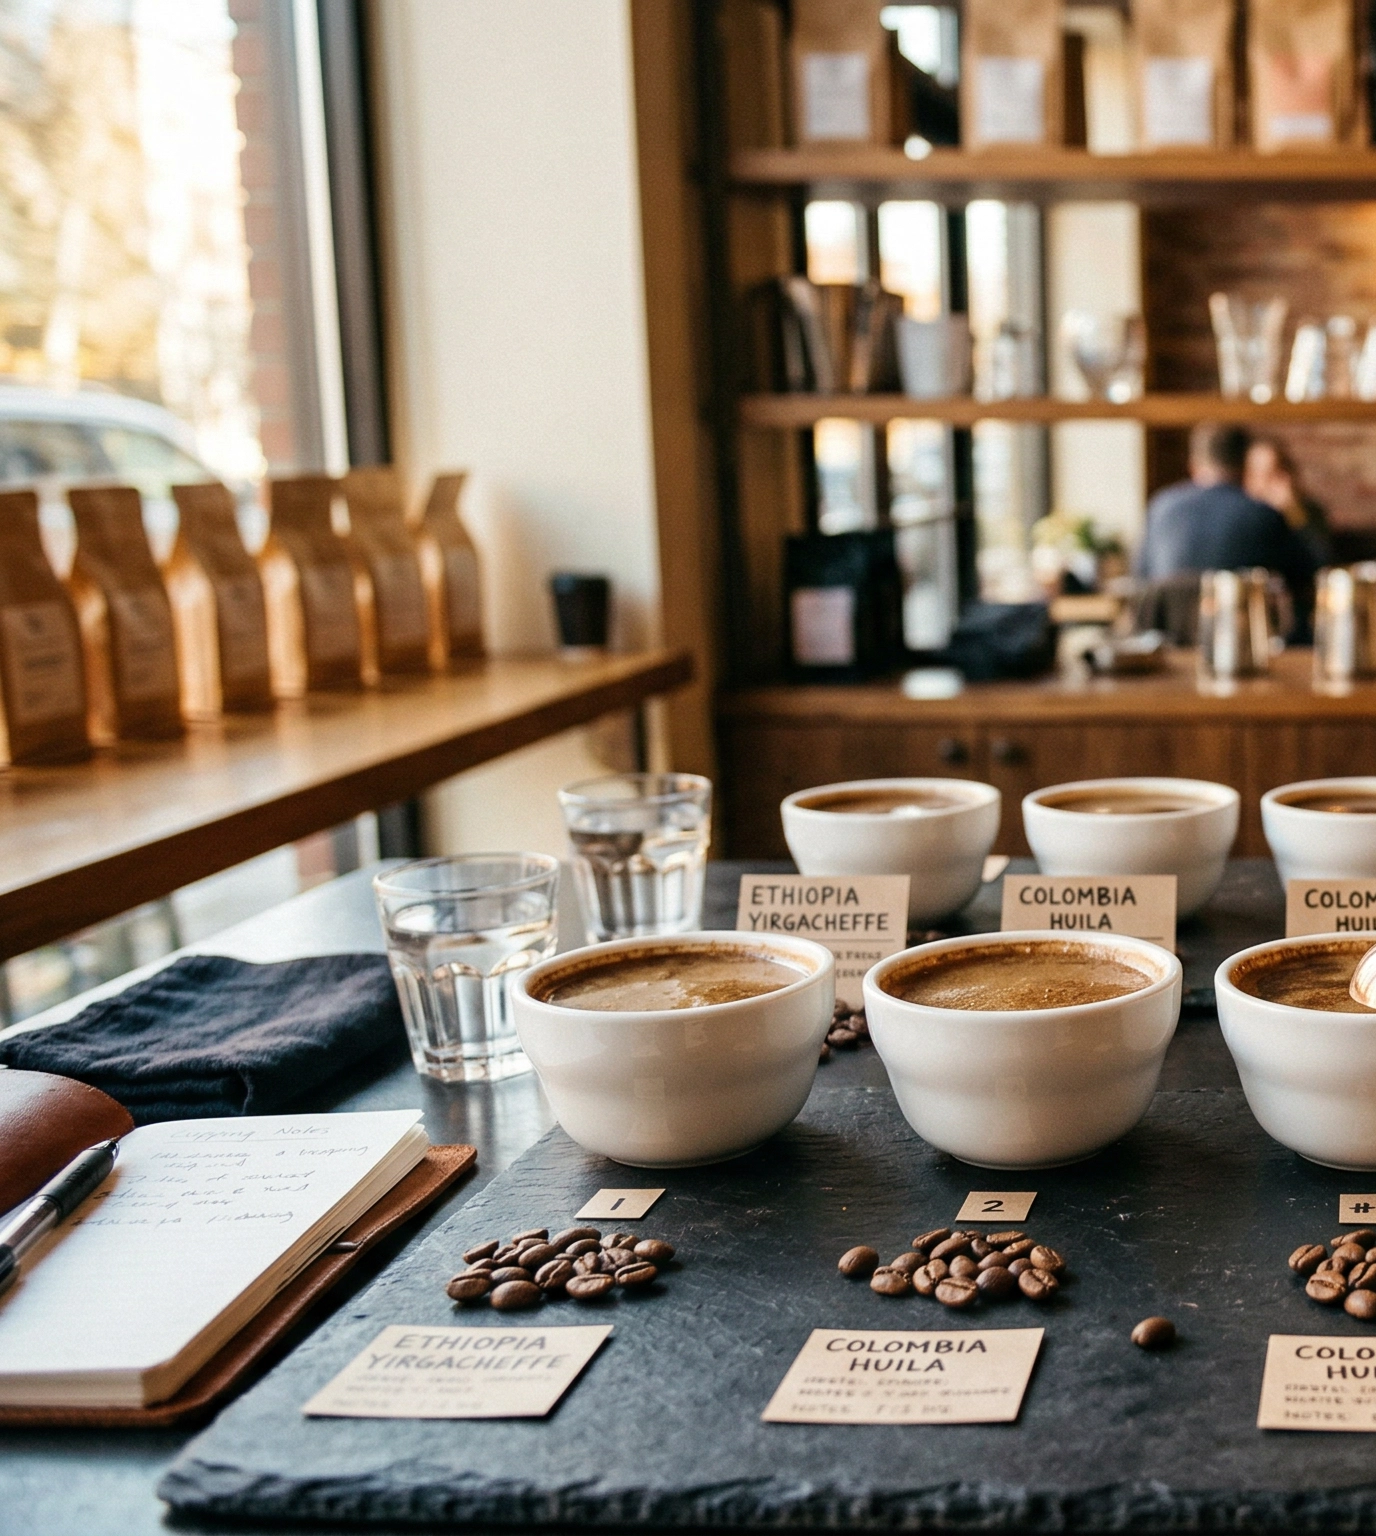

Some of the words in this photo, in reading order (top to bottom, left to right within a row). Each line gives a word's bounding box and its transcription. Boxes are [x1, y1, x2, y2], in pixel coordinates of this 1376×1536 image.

[751, 885, 860, 905] ETHIOPIA
[1019, 885, 1137, 906] COLOMBIA
[748, 911, 890, 932] YIRGACHEFFE
[1050, 912, 1113, 930] HUILA
[274, 1126, 331, 1135] Notes
[609, 1197, 626, 1211] 1
[981, 1199, 1005, 1213] 2
[394, 1334, 547, 1351] ETHIOPIA
[826, 1337, 988, 1354] COLOMBIA
[367, 1353, 571, 1371] YIRGACHEFFE
[849, 1357, 946, 1372] HUILA
